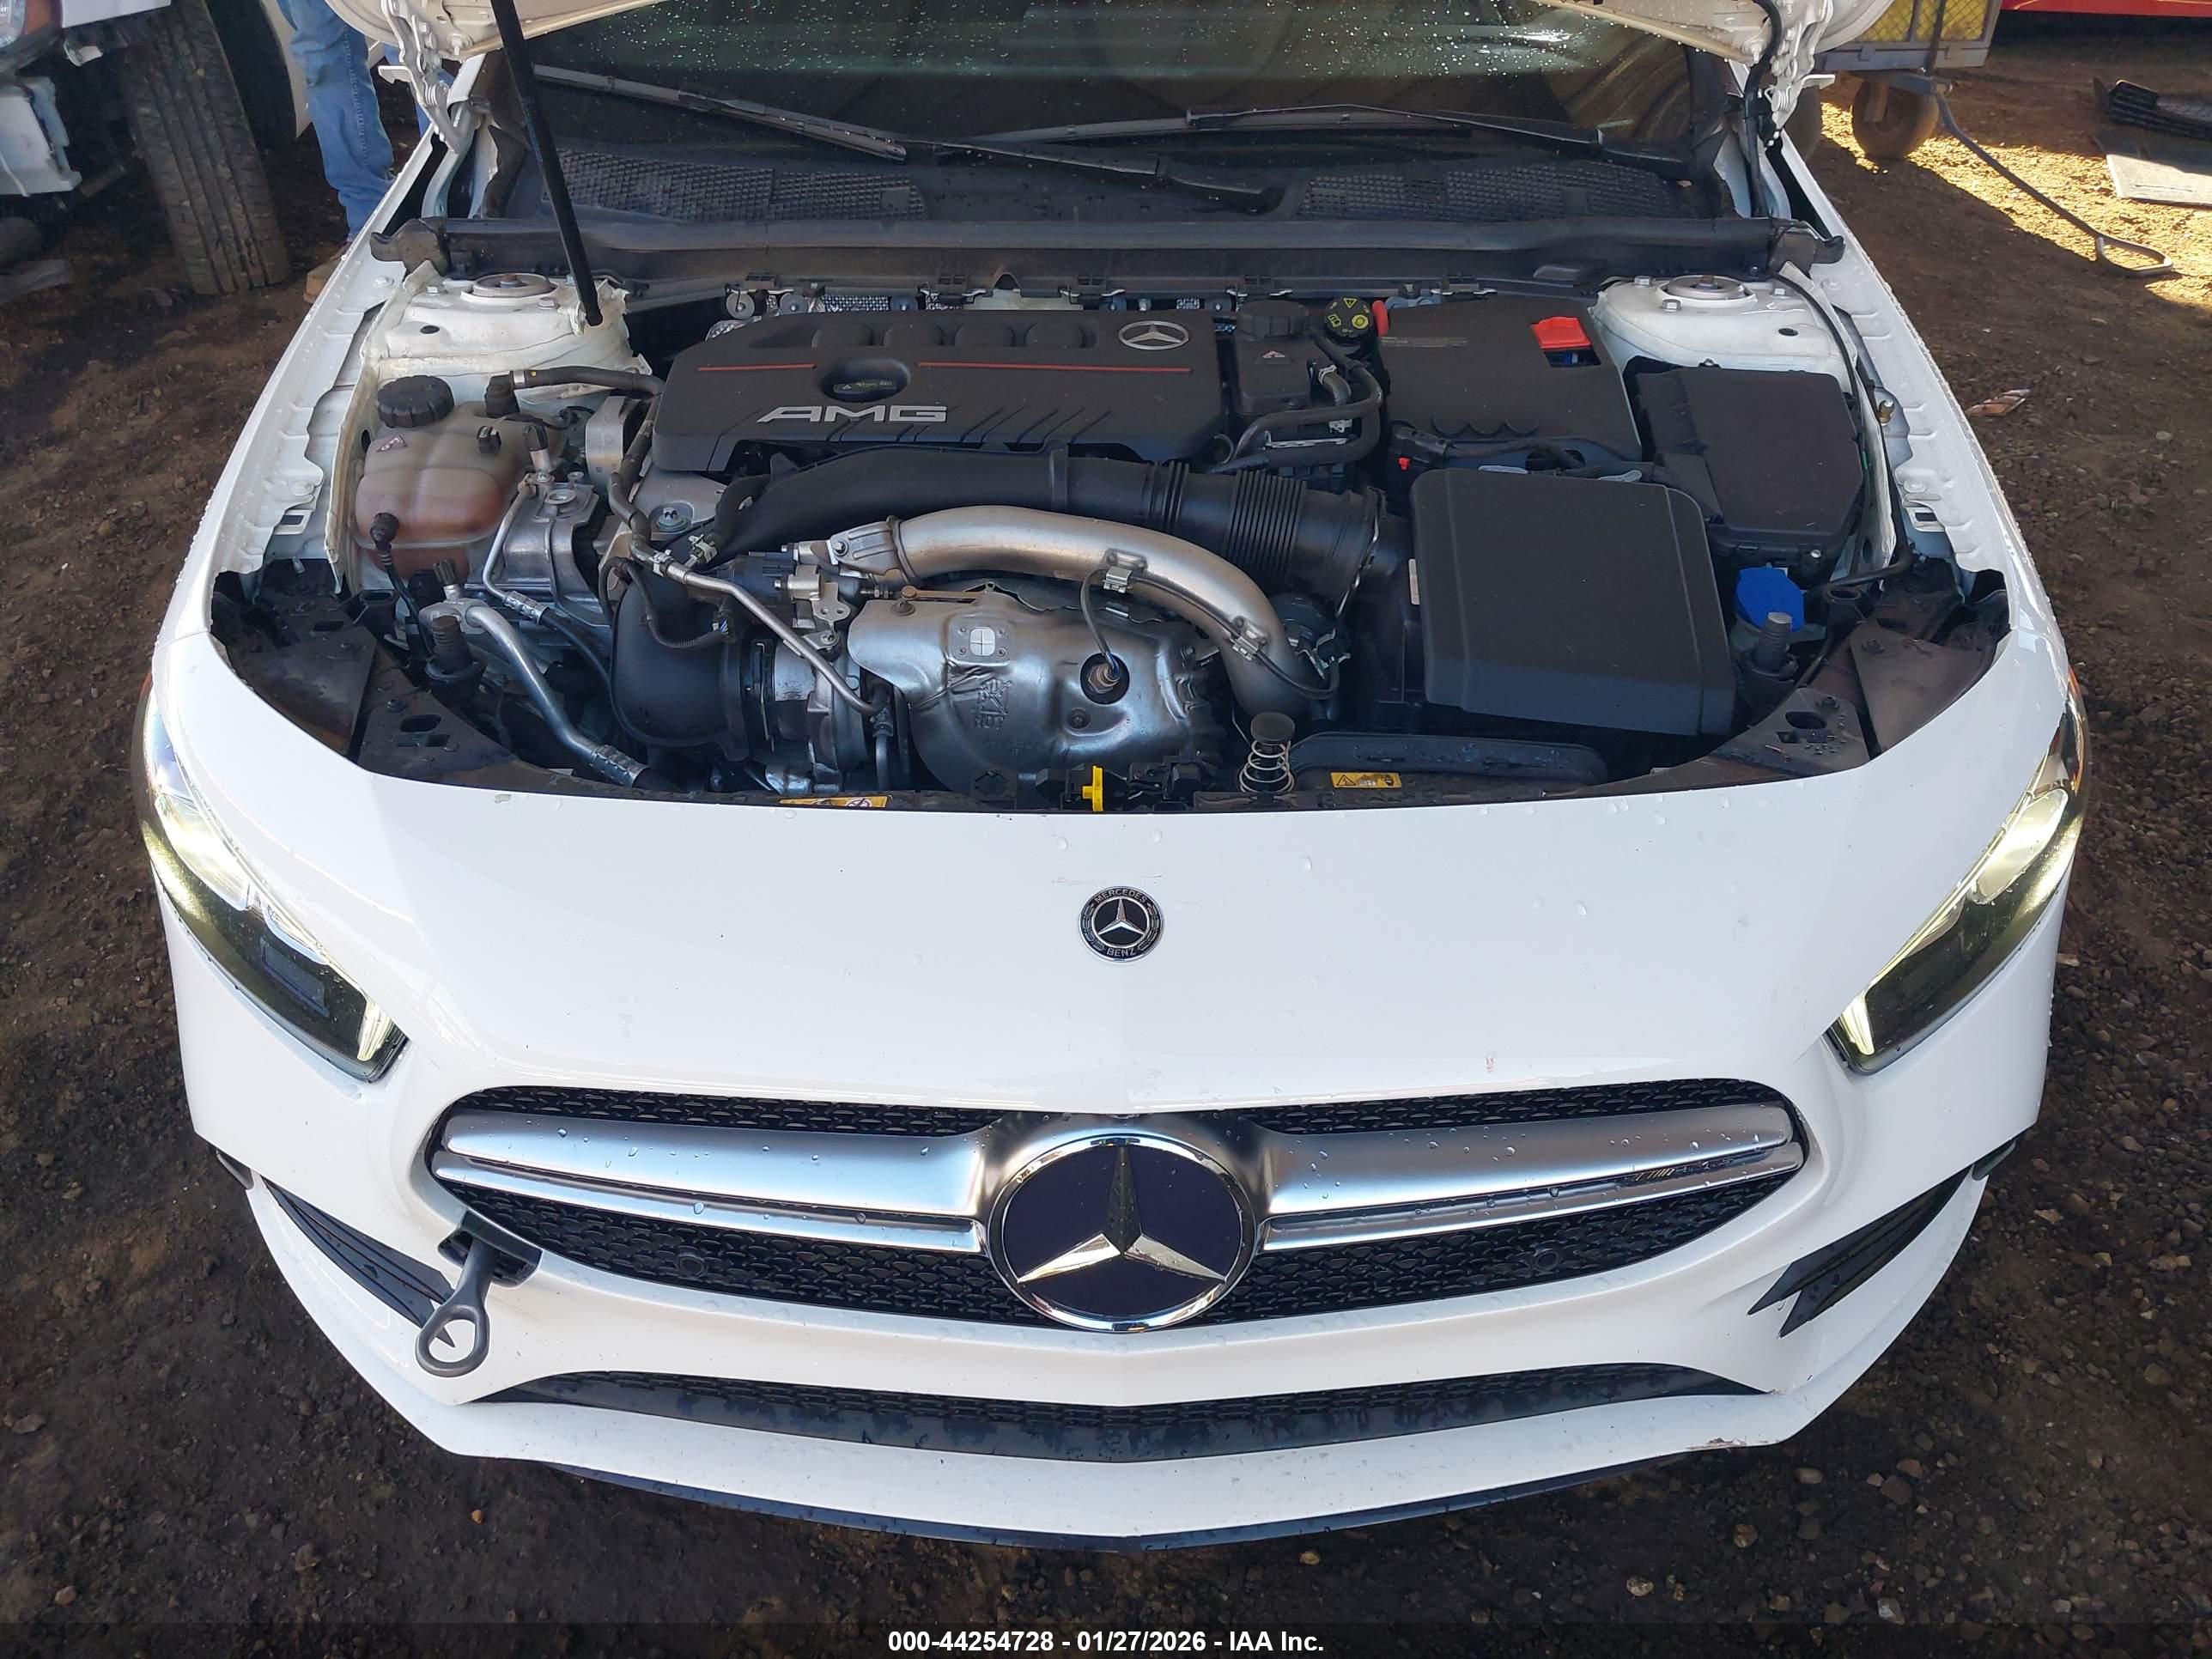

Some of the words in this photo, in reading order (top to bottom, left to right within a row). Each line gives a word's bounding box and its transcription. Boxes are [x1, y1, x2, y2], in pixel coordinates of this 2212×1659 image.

[756, 404, 948, 423] AMG
[1094, 888, 1148, 904] MERCEDES
[1106, 947, 1137, 957] BENZ
